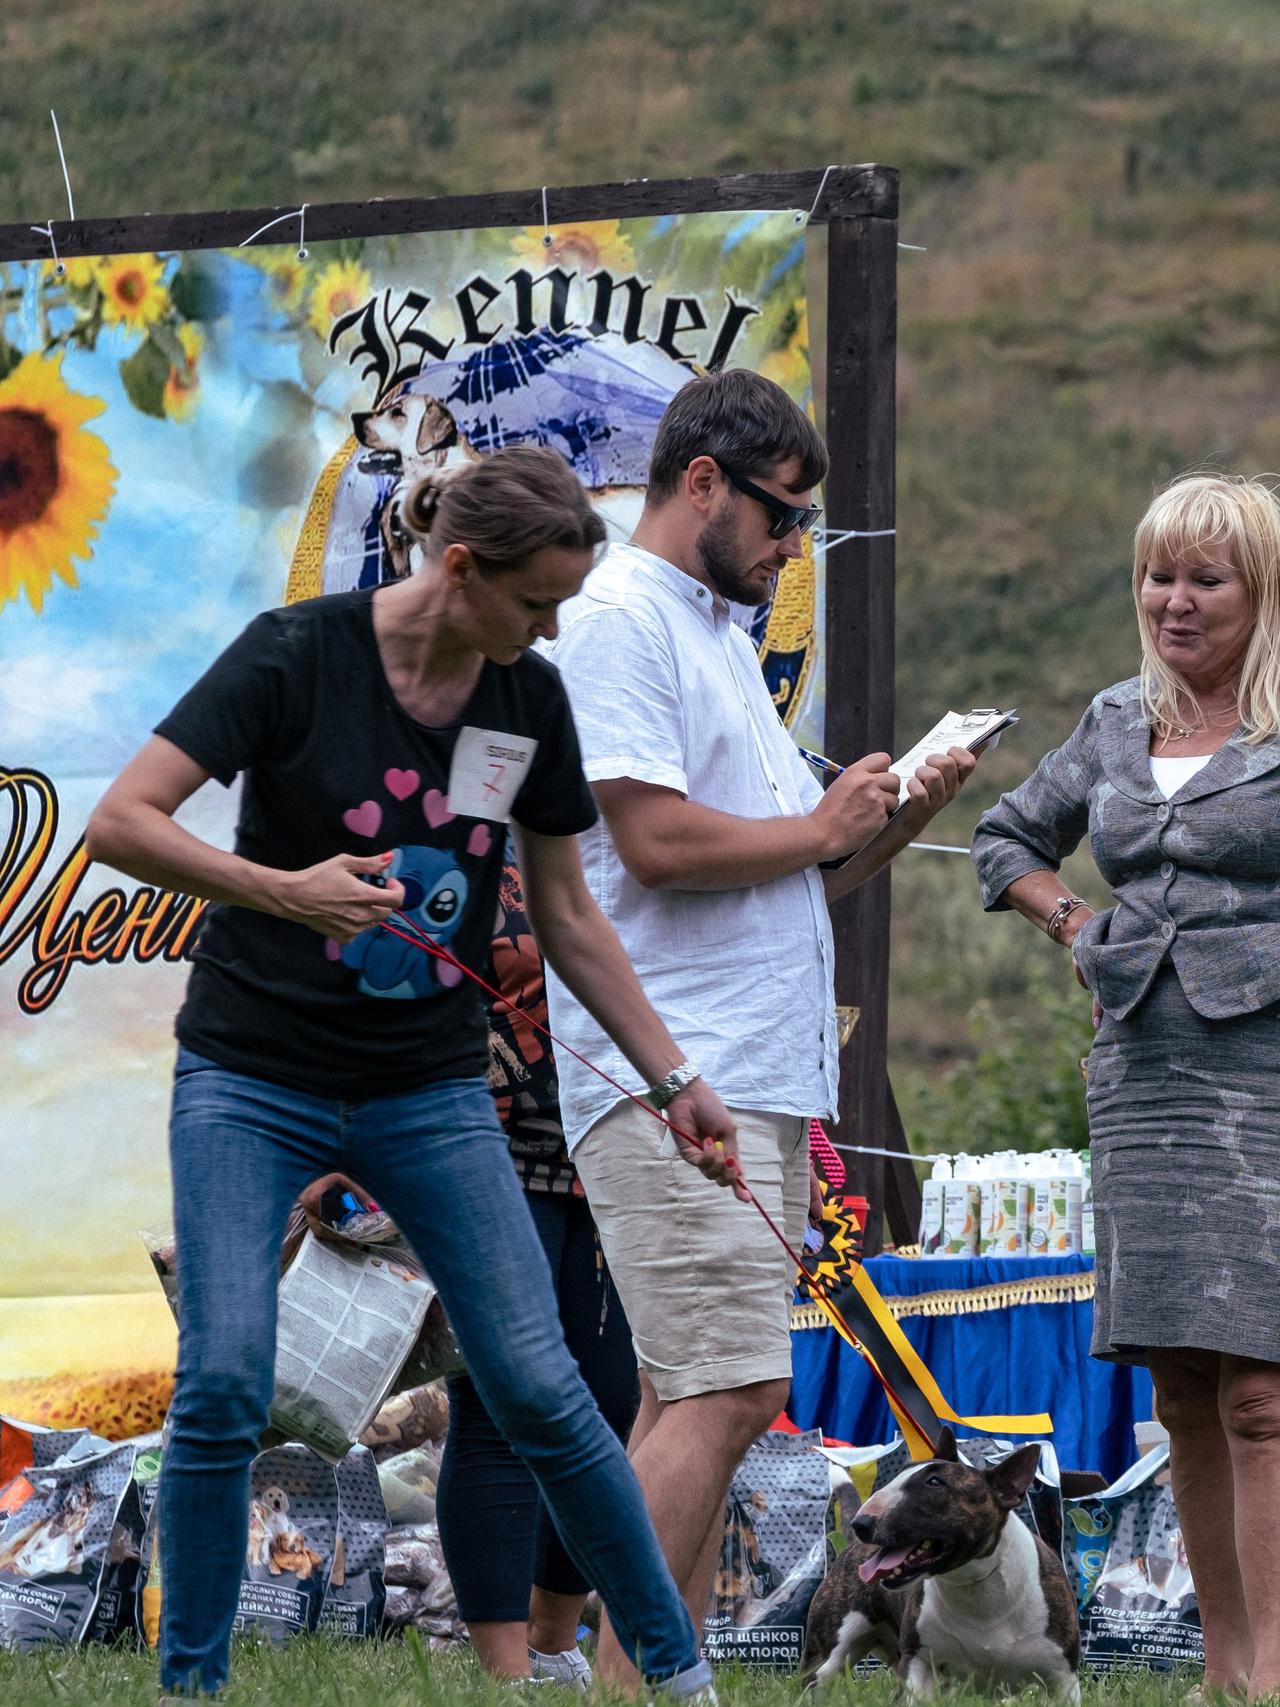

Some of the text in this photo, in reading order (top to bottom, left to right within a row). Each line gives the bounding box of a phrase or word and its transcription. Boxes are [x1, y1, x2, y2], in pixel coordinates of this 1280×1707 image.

[328, 265, 762, 405] Kennel
[30, 1588, 60, 1603] СОБАК
[240, 1584, 301, 1602] РОСЛЫХ СОБАК
[240, 1592, 301, 1610] РЕДНИХ ПОРОД
[18, 1592, 56, 1615] ПОРОД
[281, 1608, 301, 1620] РИС
[704, 1616, 731, 1627] НИОР
[1091, 1606, 1179, 1620] СУПЕР ПРЕМИУМ
[705, 1632, 800, 1645] ДЛЯ ЩЕНКОВ
[1097, 1622, 1120, 1631] КОРМ
[1187, 1631, 1204, 1639] СОБ
[1096, 1631, 1134, 1639] КРУПНЫХ
[1142, 1634, 1184, 1644] СРЕДНИХ
[1185, 1639, 1205, 1648] ПОР
[700, 1647, 800, 1659] ЕЛКИХ ПОРОД
[1131, 1643, 1205, 1660] С ГОВЯДИНО
